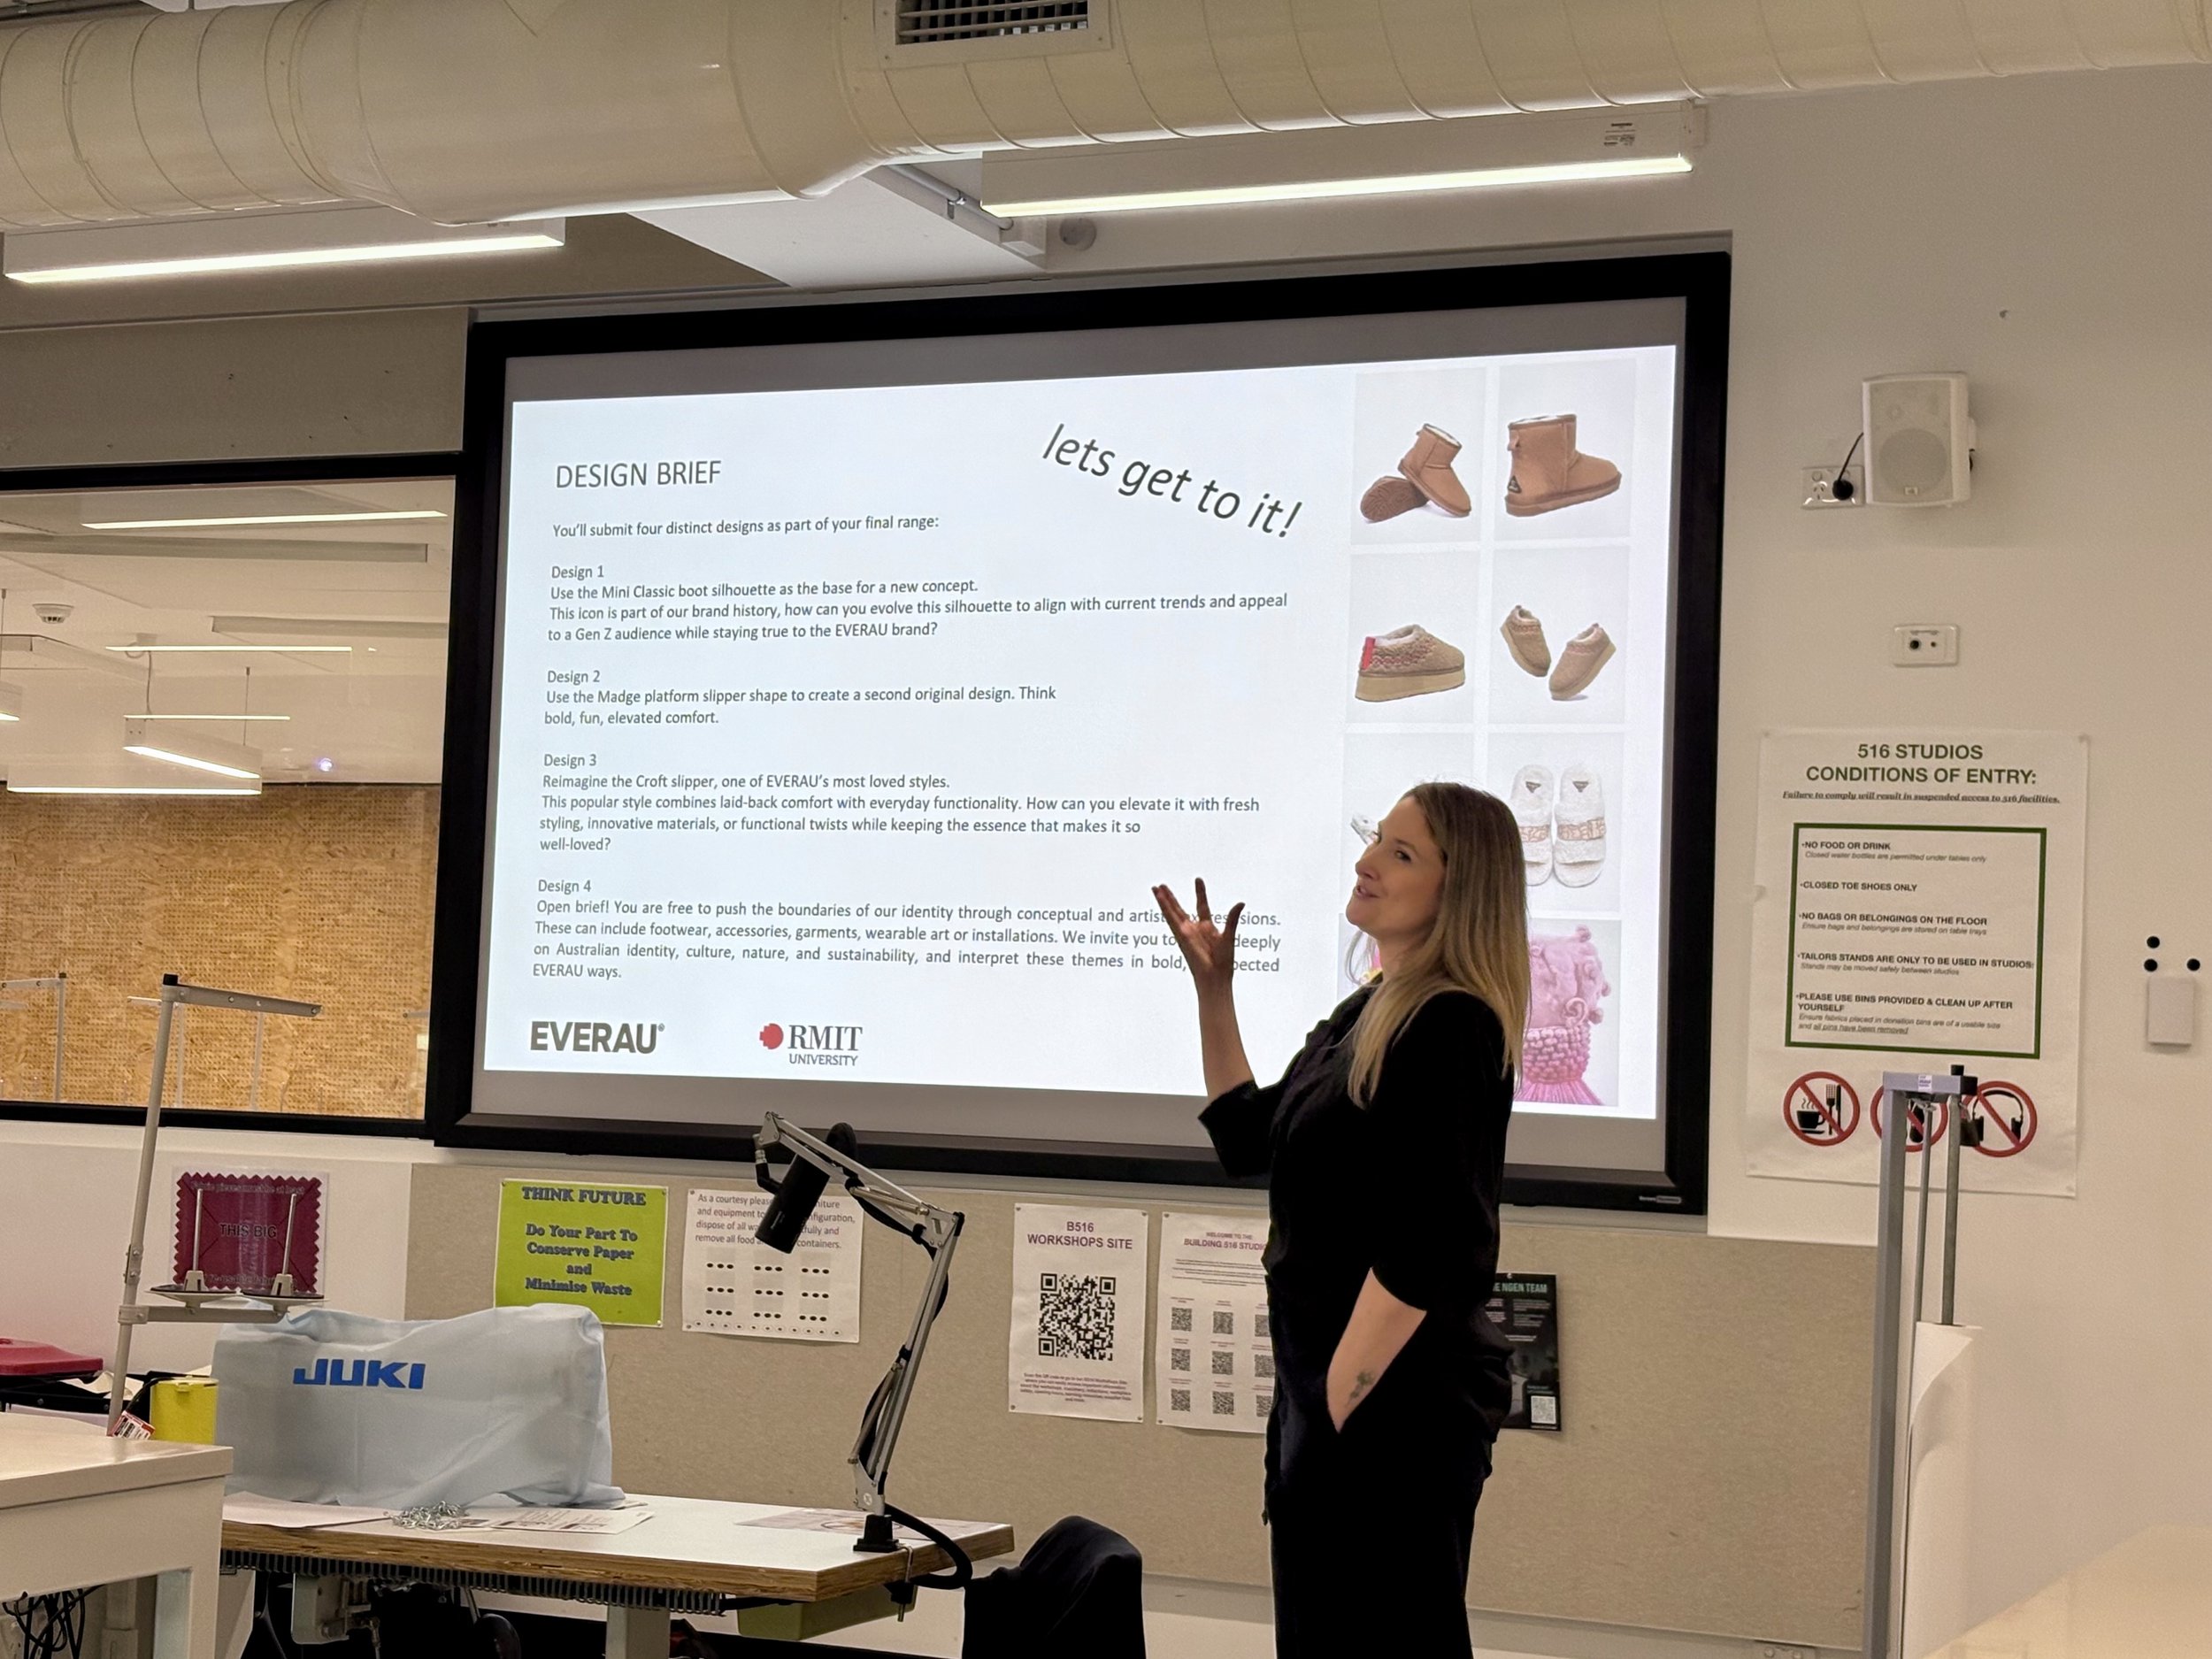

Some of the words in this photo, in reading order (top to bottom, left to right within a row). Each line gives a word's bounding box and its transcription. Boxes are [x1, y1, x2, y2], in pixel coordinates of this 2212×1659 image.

[557, 463, 647, 488] DESIGN
[657, 460, 721, 485] BRIEF
[1042, 423, 1116, 477] lets
[1118, 459, 1192, 503] get
[1196, 479, 1240, 519] to
[1248, 492, 1302, 539] it!
[551, 565, 593, 581] Design
[597, 565, 604, 578] 1
[551, 587, 573, 600] Use
[578, 586, 598, 599] the
[602, 586, 630, 598] Mini
[634, 585, 675, 598] Classic
[679, 584, 708, 597] boot
[711, 583, 776, 596] silhouette
[780, 585, 793, 595] as
[797, 581, 818, 595] the
[822, 580, 853, 595] base
[856, 580, 876, 594] for
[879, 583, 886, 593] a
[890, 583, 918, 593] new
[922, 580, 978, 595] concept.
[548, 630, 561, 641] to
[565, 631, 572, 641] a
[575, 627, 600, 641] Gen
[603, 627, 612, 641] Z
[615, 626, 672, 640] audience
[675, 626, 710, 639] while
[713, 626, 758, 641] staying
[762, 626, 788, 638] true
[792, 626, 806, 637] to
[810, 624, 832, 637] the
[835, 623, 887, 637] EVERAU
[892, 621, 938, 636] brand?
[548, 670, 588, 686] Design
[593, 670, 600, 683] 2
[547, 691, 570, 703] Use
[573, 689, 594, 703] the
[597, 689, 641, 706] Madge
[644, 688, 699, 705] platform
[703, 688, 747, 705] slipper
[749, 688, 787, 705] shape
[791, 690, 805, 702] to
[808, 689, 849, 701] create
[853, 691, 861, 701] a
[864, 687, 911, 701] second
[915, 687, 964, 703] original
[968, 687, 1015, 703] design.
[1018, 686, 1056, 699] Think
[544, 710, 575, 726] bold,
[580, 710, 603, 726] fun,
[608, 710, 662, 724] elevated
[665, 710, 718, 724] comfort.
[1858, 744, 1890, 758] 516
[1895, 744, 1983, 759] STUDIOS
[544, 754, 585, 770] Design
[589, 753, 596, 766] 3
[1807, 767, 1928, 782] CONDITIONS
[1934, 768, 1961, 782] OF
[1967, 769, 2036, 784] ENTRY:
[538, 879, 580, 895] Design
[583, 879, 591, 892] 4
[1860, 914, 1917, 923] BELONGINGS
[1956, 917, 1987, 926] FLOOR
[1839, 954, 1874, 963] STANDS
[533, 964, 583, 977] EVERAU
[587, 967, 622, 980] ways.
[1878, 996, 1924, 1005] PROVIDED
[1935, 998, 1965, 1007] CLEAN
[788, 1025, 863, 1051] RMIT
[788, 1053, 858, 1066] UNIVERSITY
[522, 1187, 575, 1202] THINK
[579, 1190, 646, 1205] FUTURE
[716, 1196, 748, 1205] courtesy
[219, 1224, 249, 1237] THIS
[253, 1225, 277, 1239] BIG
[526, 1224, 545, 1236] Do
[549, 1225, 582, 1238] Your
[585, 1227, 616, 1240] Part
[619, 1229, 638, 1241] To
[696, 1220, 725, 1230] dispose
[726, 1221, 735, 1230] of
[736, 1222, 747, 1231] all
[1067, 1221, 1094, 1232] B516
[737, 1234, 755, 1244] food
[1028, 1234, 1103, 1247] WORKSHOPS
[1107, 1239, 1133, 1249] SITE
[1184, 1239, 1222, 1248] BUILDING
[527, 1242, 589, 1256] Conserve
[594, 1246, 634, 1261] Paper
[566, 1263, 592, 1275] and
[526, 1278, 588, 1292] Minimise
[591, 1282, 632, 1295] Waste
[293, 1358, 426, 1390] JUKI
